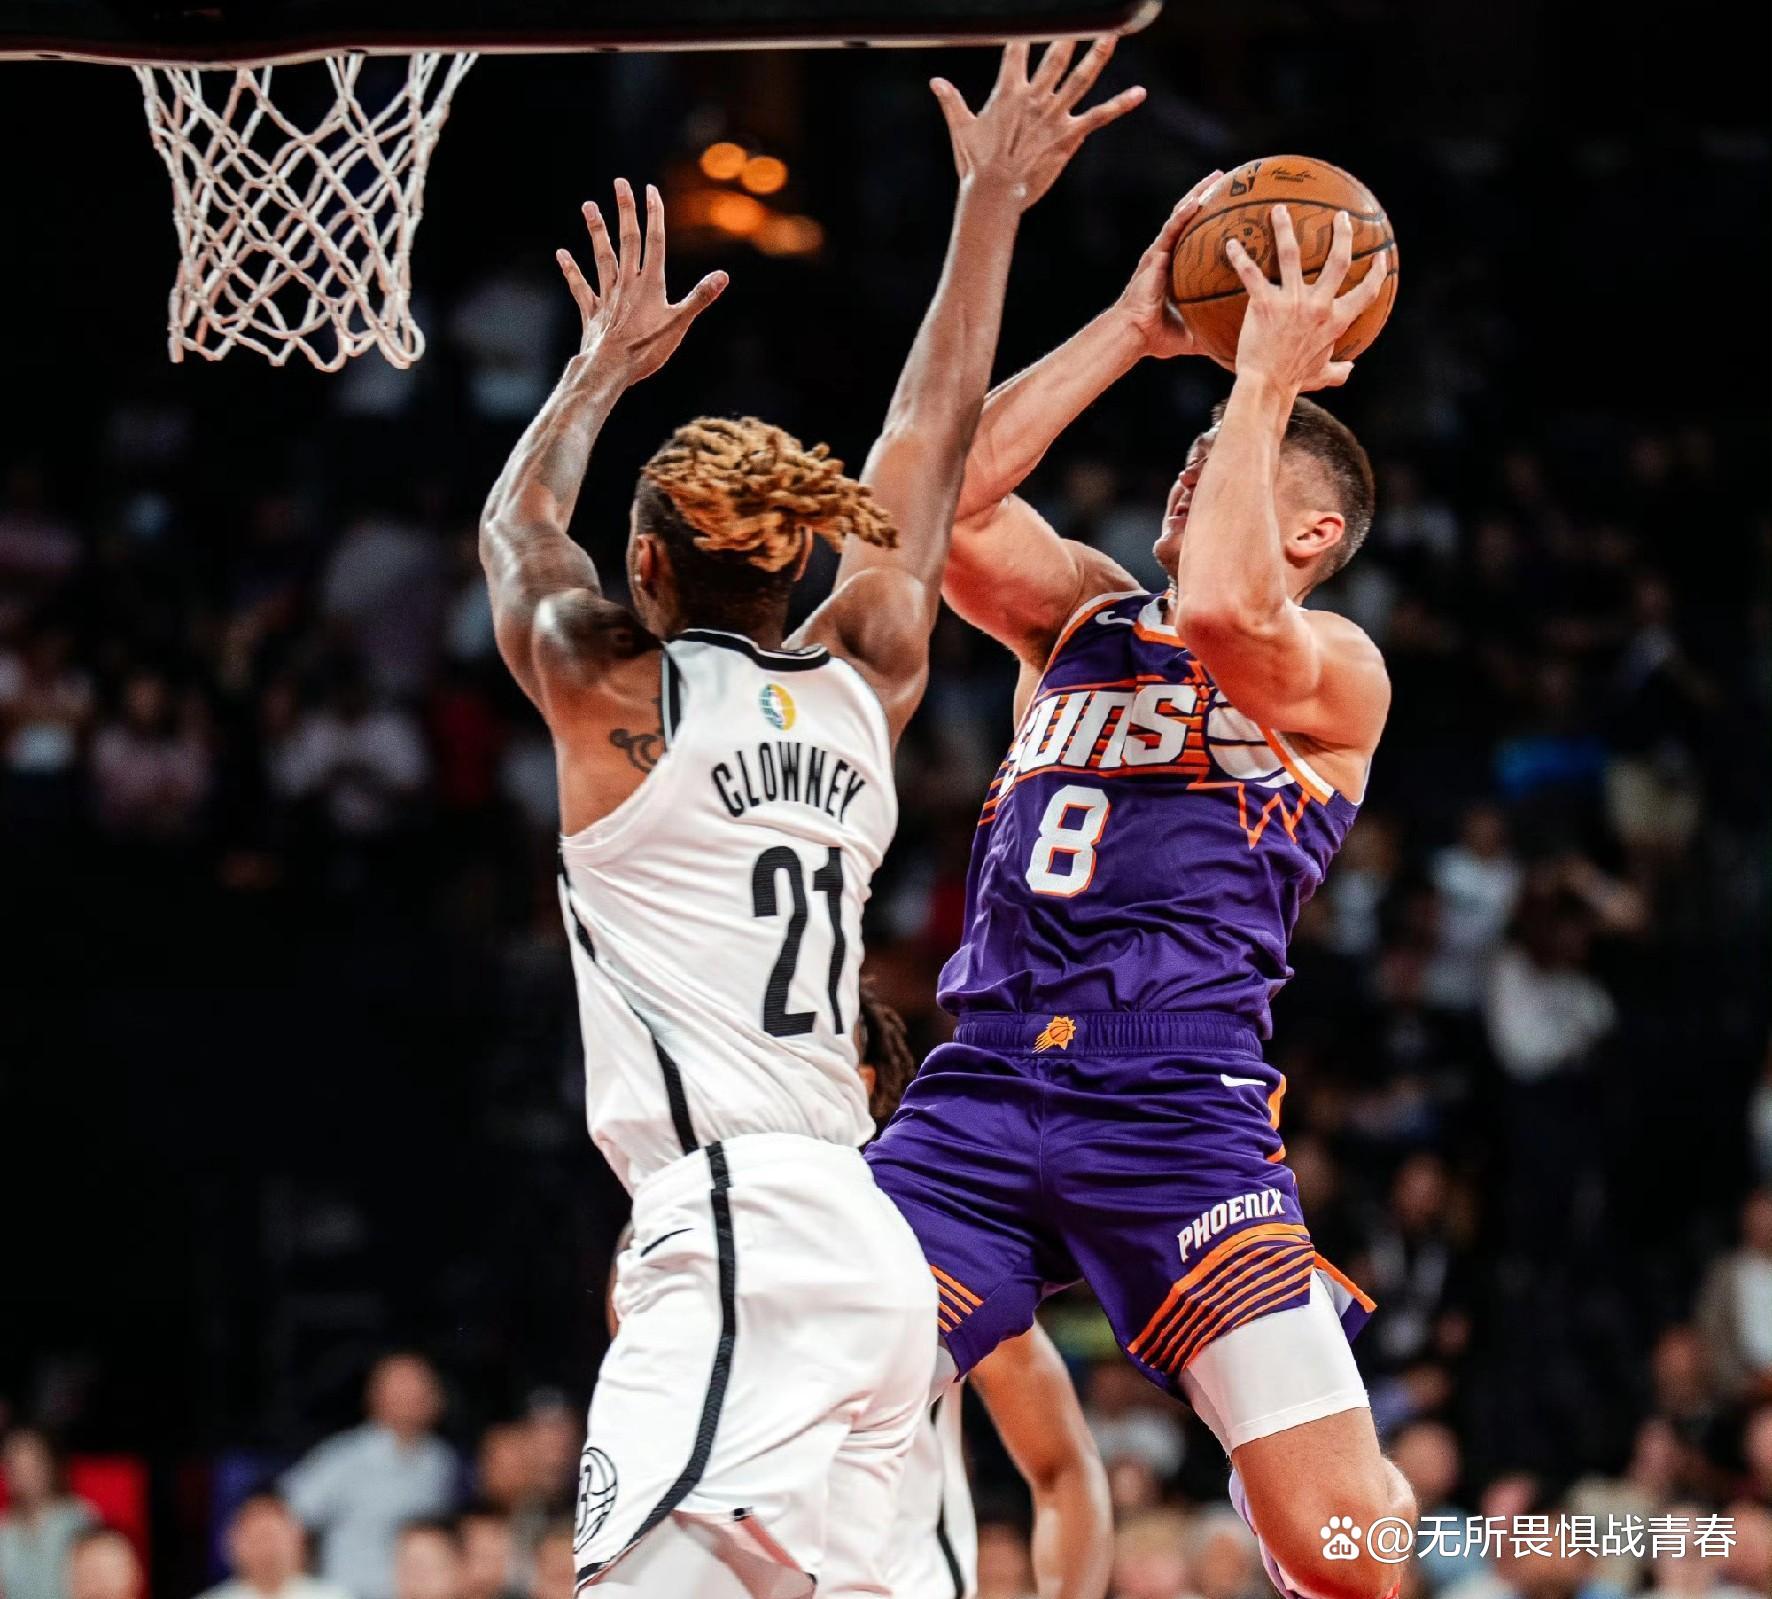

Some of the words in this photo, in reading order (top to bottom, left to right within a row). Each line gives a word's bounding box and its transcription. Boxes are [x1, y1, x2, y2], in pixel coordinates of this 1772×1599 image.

[711, 741, 866, 824] CLOWNEY
[1025, 784, 1112, 898] 8
[752, 845, 846, 1038] 21
[1177, 1188, 1287, 1264] PHOENIX
